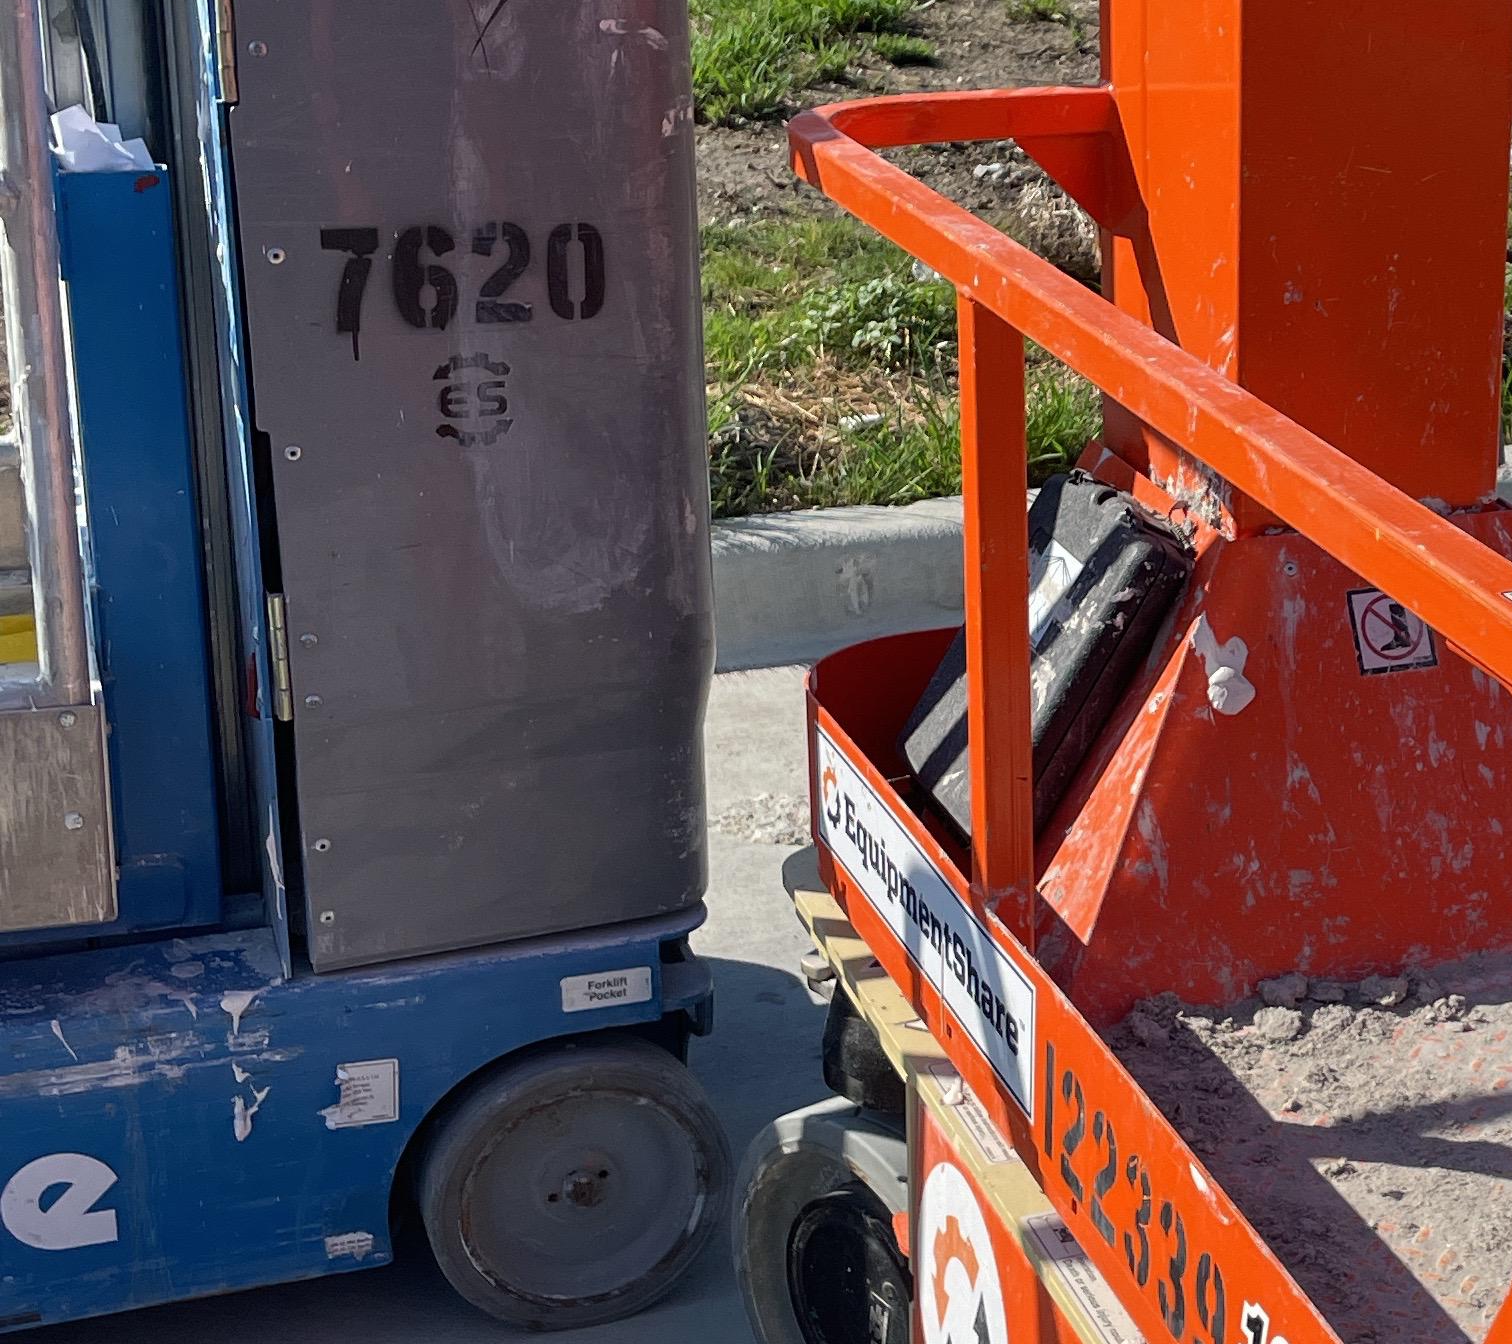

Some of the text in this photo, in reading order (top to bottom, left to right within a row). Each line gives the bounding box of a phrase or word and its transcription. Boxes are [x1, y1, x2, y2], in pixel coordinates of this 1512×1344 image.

[319, 221, 606, 336] 7620
[843, 794, 1021, 1056] EquipmentShare
[587, 976, 628, 991] Forklift
[589, 988, 627, 1002] Pocket
